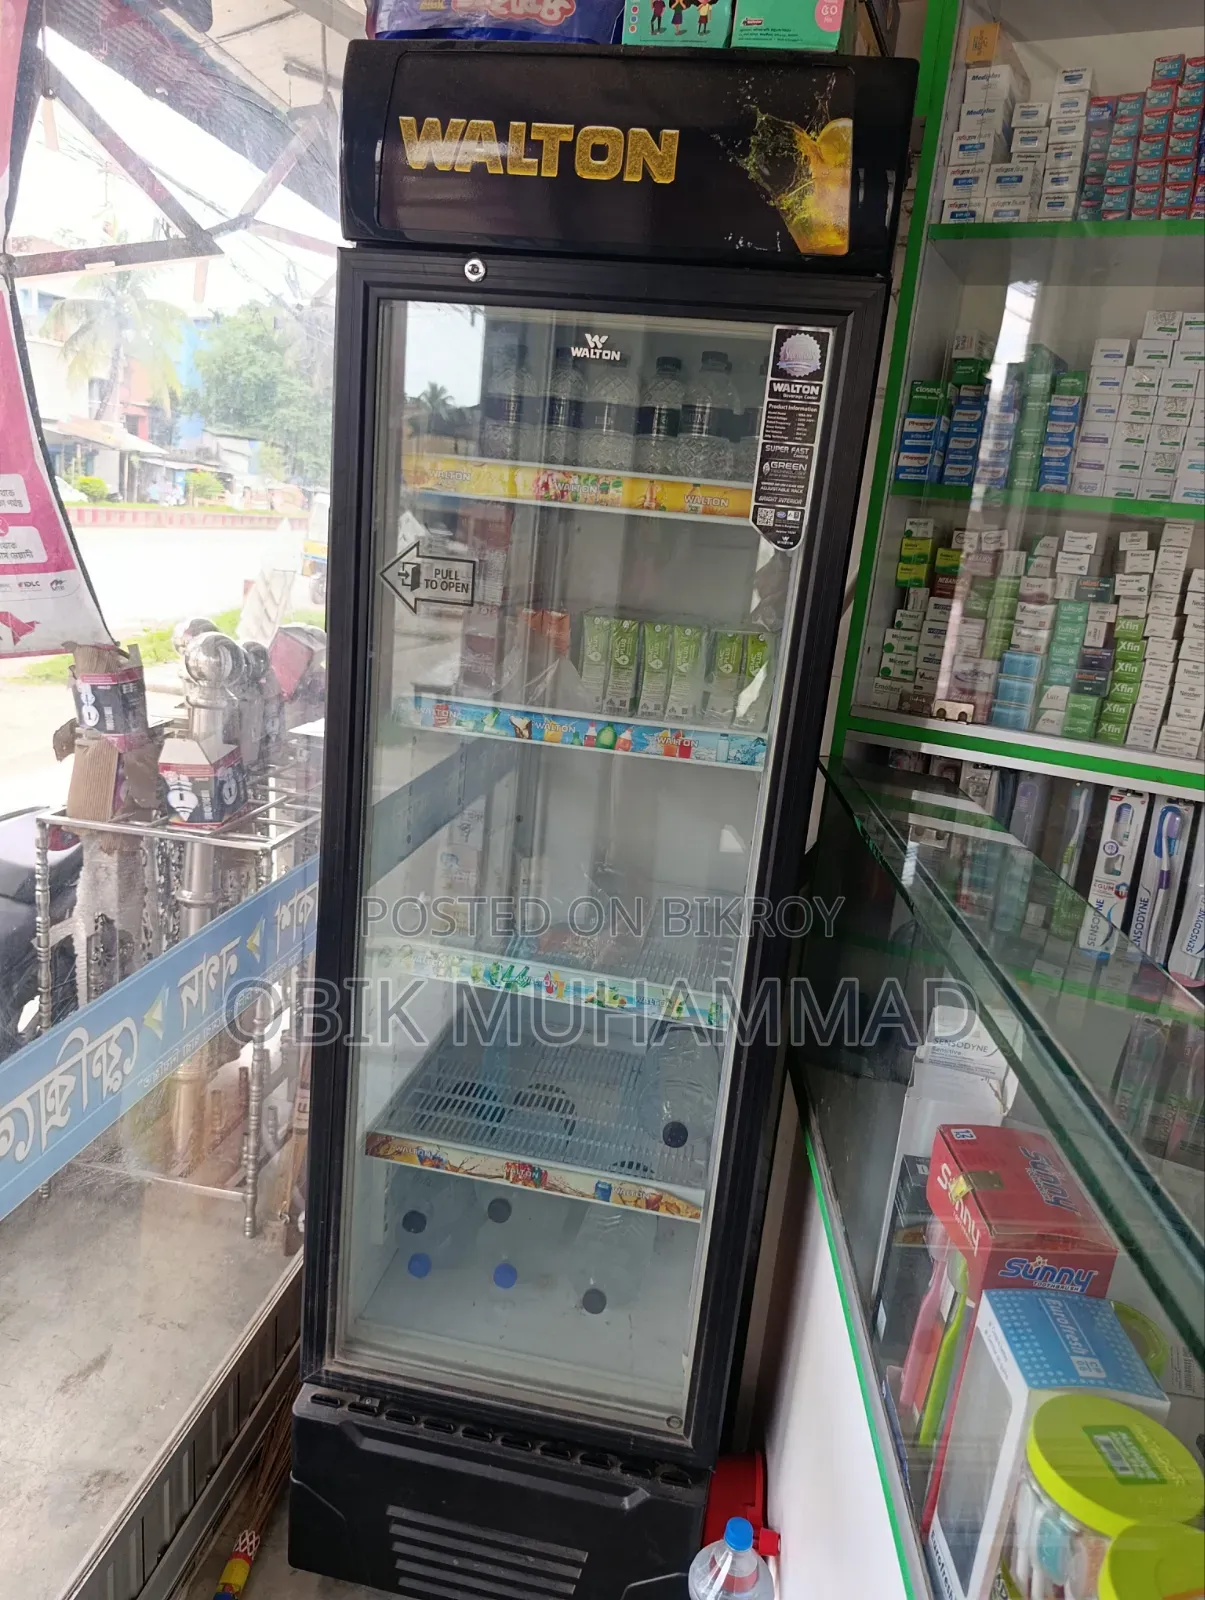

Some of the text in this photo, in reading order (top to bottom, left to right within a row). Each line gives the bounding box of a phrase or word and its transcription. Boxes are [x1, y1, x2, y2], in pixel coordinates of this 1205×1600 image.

[966, 108, 996, 116] Mediplus
[398, 115, 680, 184] WALTON
[570, 347, 621, 361] WALTON
[773, 382, 820, 395] WALTON
[765, 444, 789, 453] SUPER
[771, 461, 807, 471] GREEN
[428, 469, 472, 481] WALTON
[554, 482, 598, 494] WALTON
[684, 495, 729, 507] WALTON
[434, 568, 461, 581] PULL
[424, 579, 470, 594] TO OPEN
[1116, 620, 1139, 631] Xfin
[1117, 641, 1140, 652] Xfin
[1115, 662, 1138, 673] Xfin
[1111, 682, 1134, 693] Xfin
[1103, 702, 1126, 713] Xfin
[535, 721, 576, 733] WALTON
[1098, 722, 1121, 733] Xfin
[656, 736, 700, 748] WALTON
[1098, 883, 1114, 891] GUM
[1133, 897, 1150, 947] ENSODYNE
[934, 1037, 989, 1053] SENSODYNE
[396, 1146, 431, 1157] WALTON
[503, 1166, 539, 1179] WALTON
[612, 1187, 649, 1199] WALTON
[937, 1162, 981, 1257] Snny
[998, 1257, 1098, 1293] Sunny
[1033, 1280, 1081, 1292] TOOTHBRUSH
